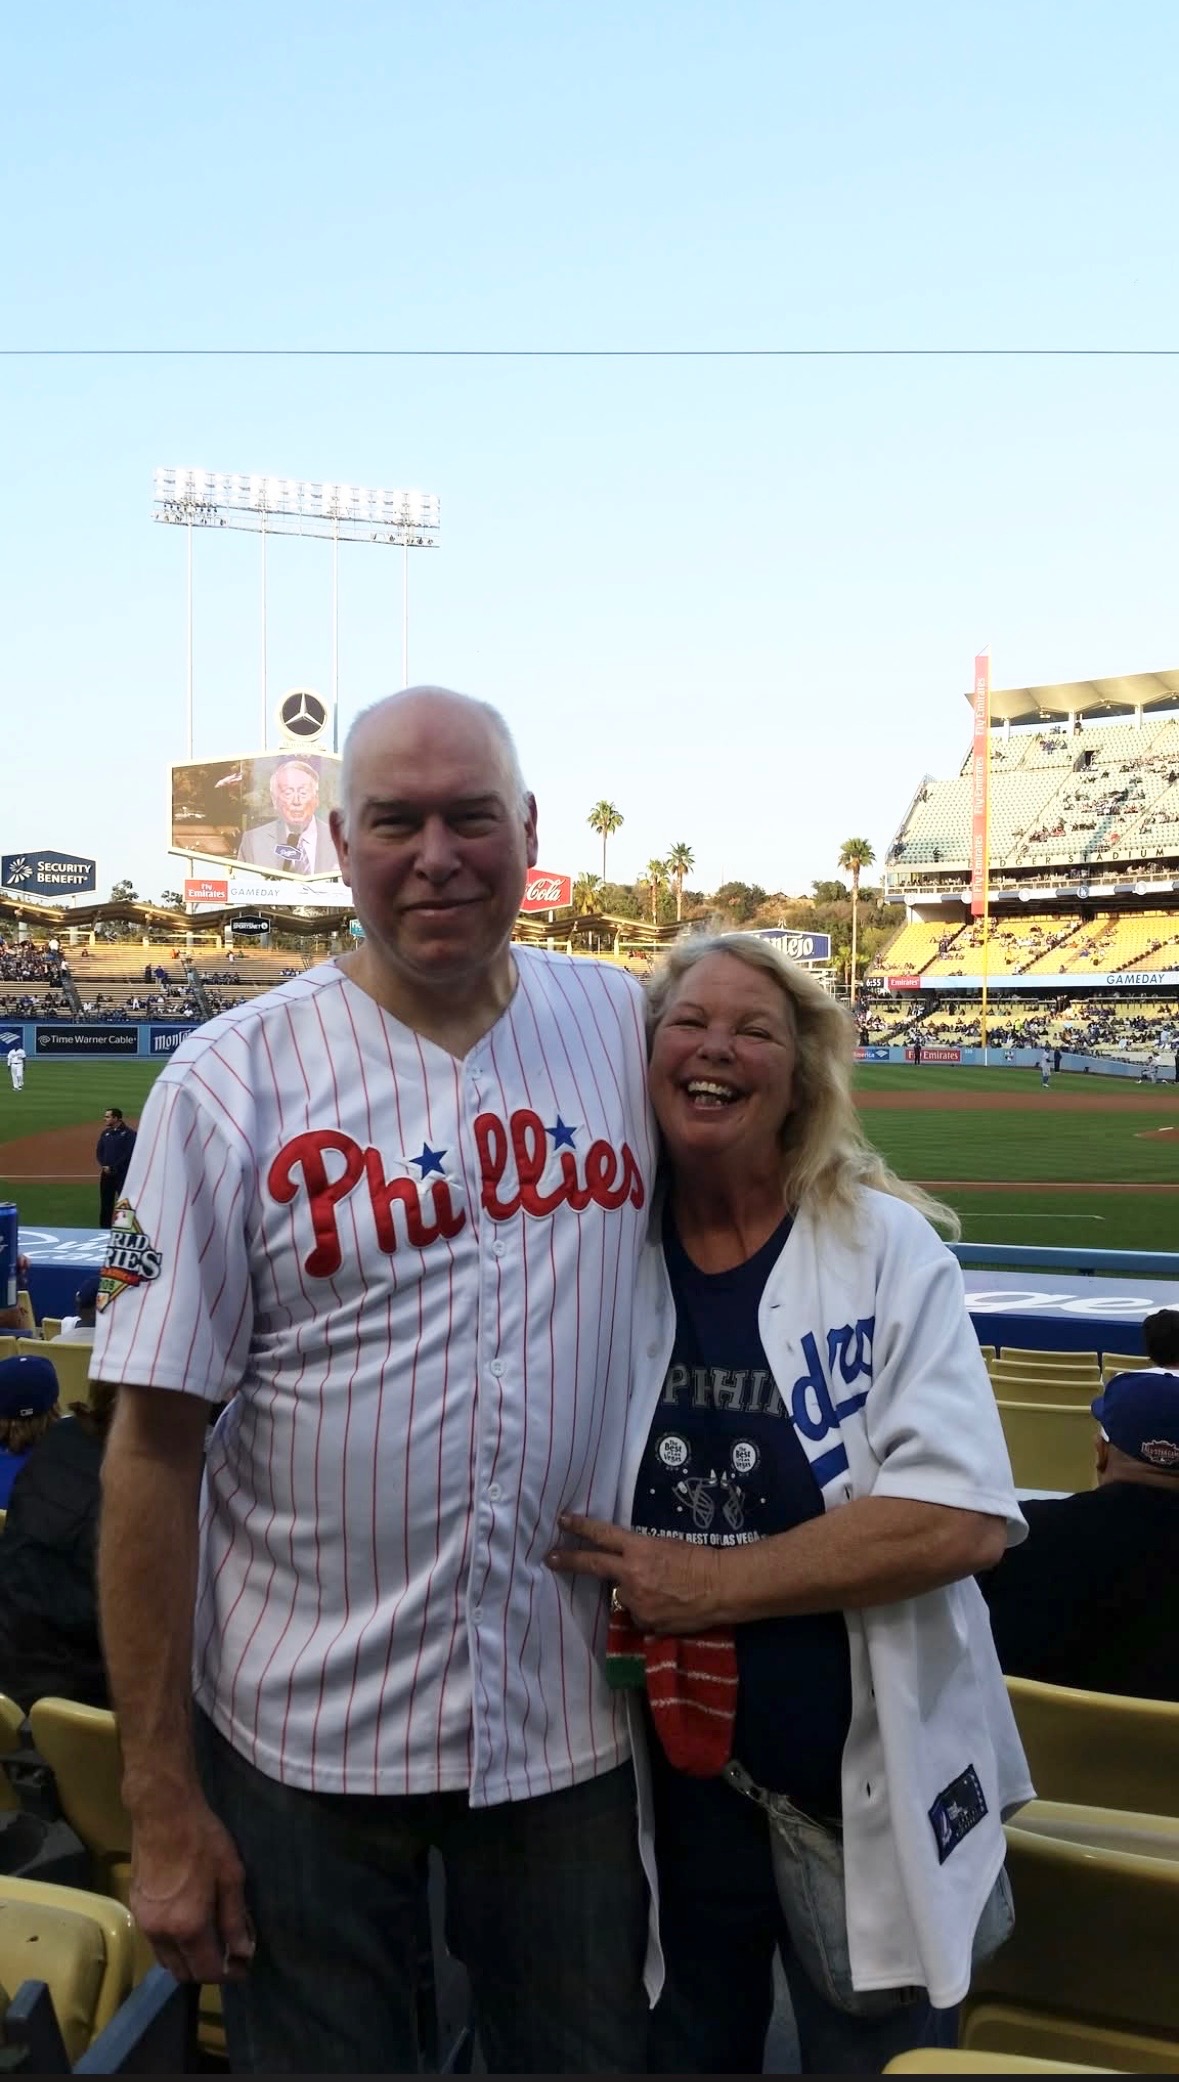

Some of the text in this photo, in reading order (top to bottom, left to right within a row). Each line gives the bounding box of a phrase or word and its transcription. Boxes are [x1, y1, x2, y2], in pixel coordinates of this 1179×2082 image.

[1069, 849, 1164, 863] STADIUM
[37, 861, 91, 874] SECURITY
[188, 888, 225, 899] Emirates
[230, 887, 281, 897] GAMEDAY
[755, 933, 814, 959] ntejo
[866, 979, 881, 987] 6:55
[1106, 974, 1165, 984] GAMEDAY
[51, 1035, 134, 1045] Time Warner Cable
[923, 1051, 958, 1060] Emirates
[268, 1108, 645, 1279] Phillies
[110, 1232, 149, 1251] RLD
[665, 1443, 682, 1453] Best
[664, 1453, 681, 1463] Vegas
[736, 1450, 751, 1459] Best
[737, 1461, 751, 1469] Vegas
[736, 1531, 767, 1545] VEGA
